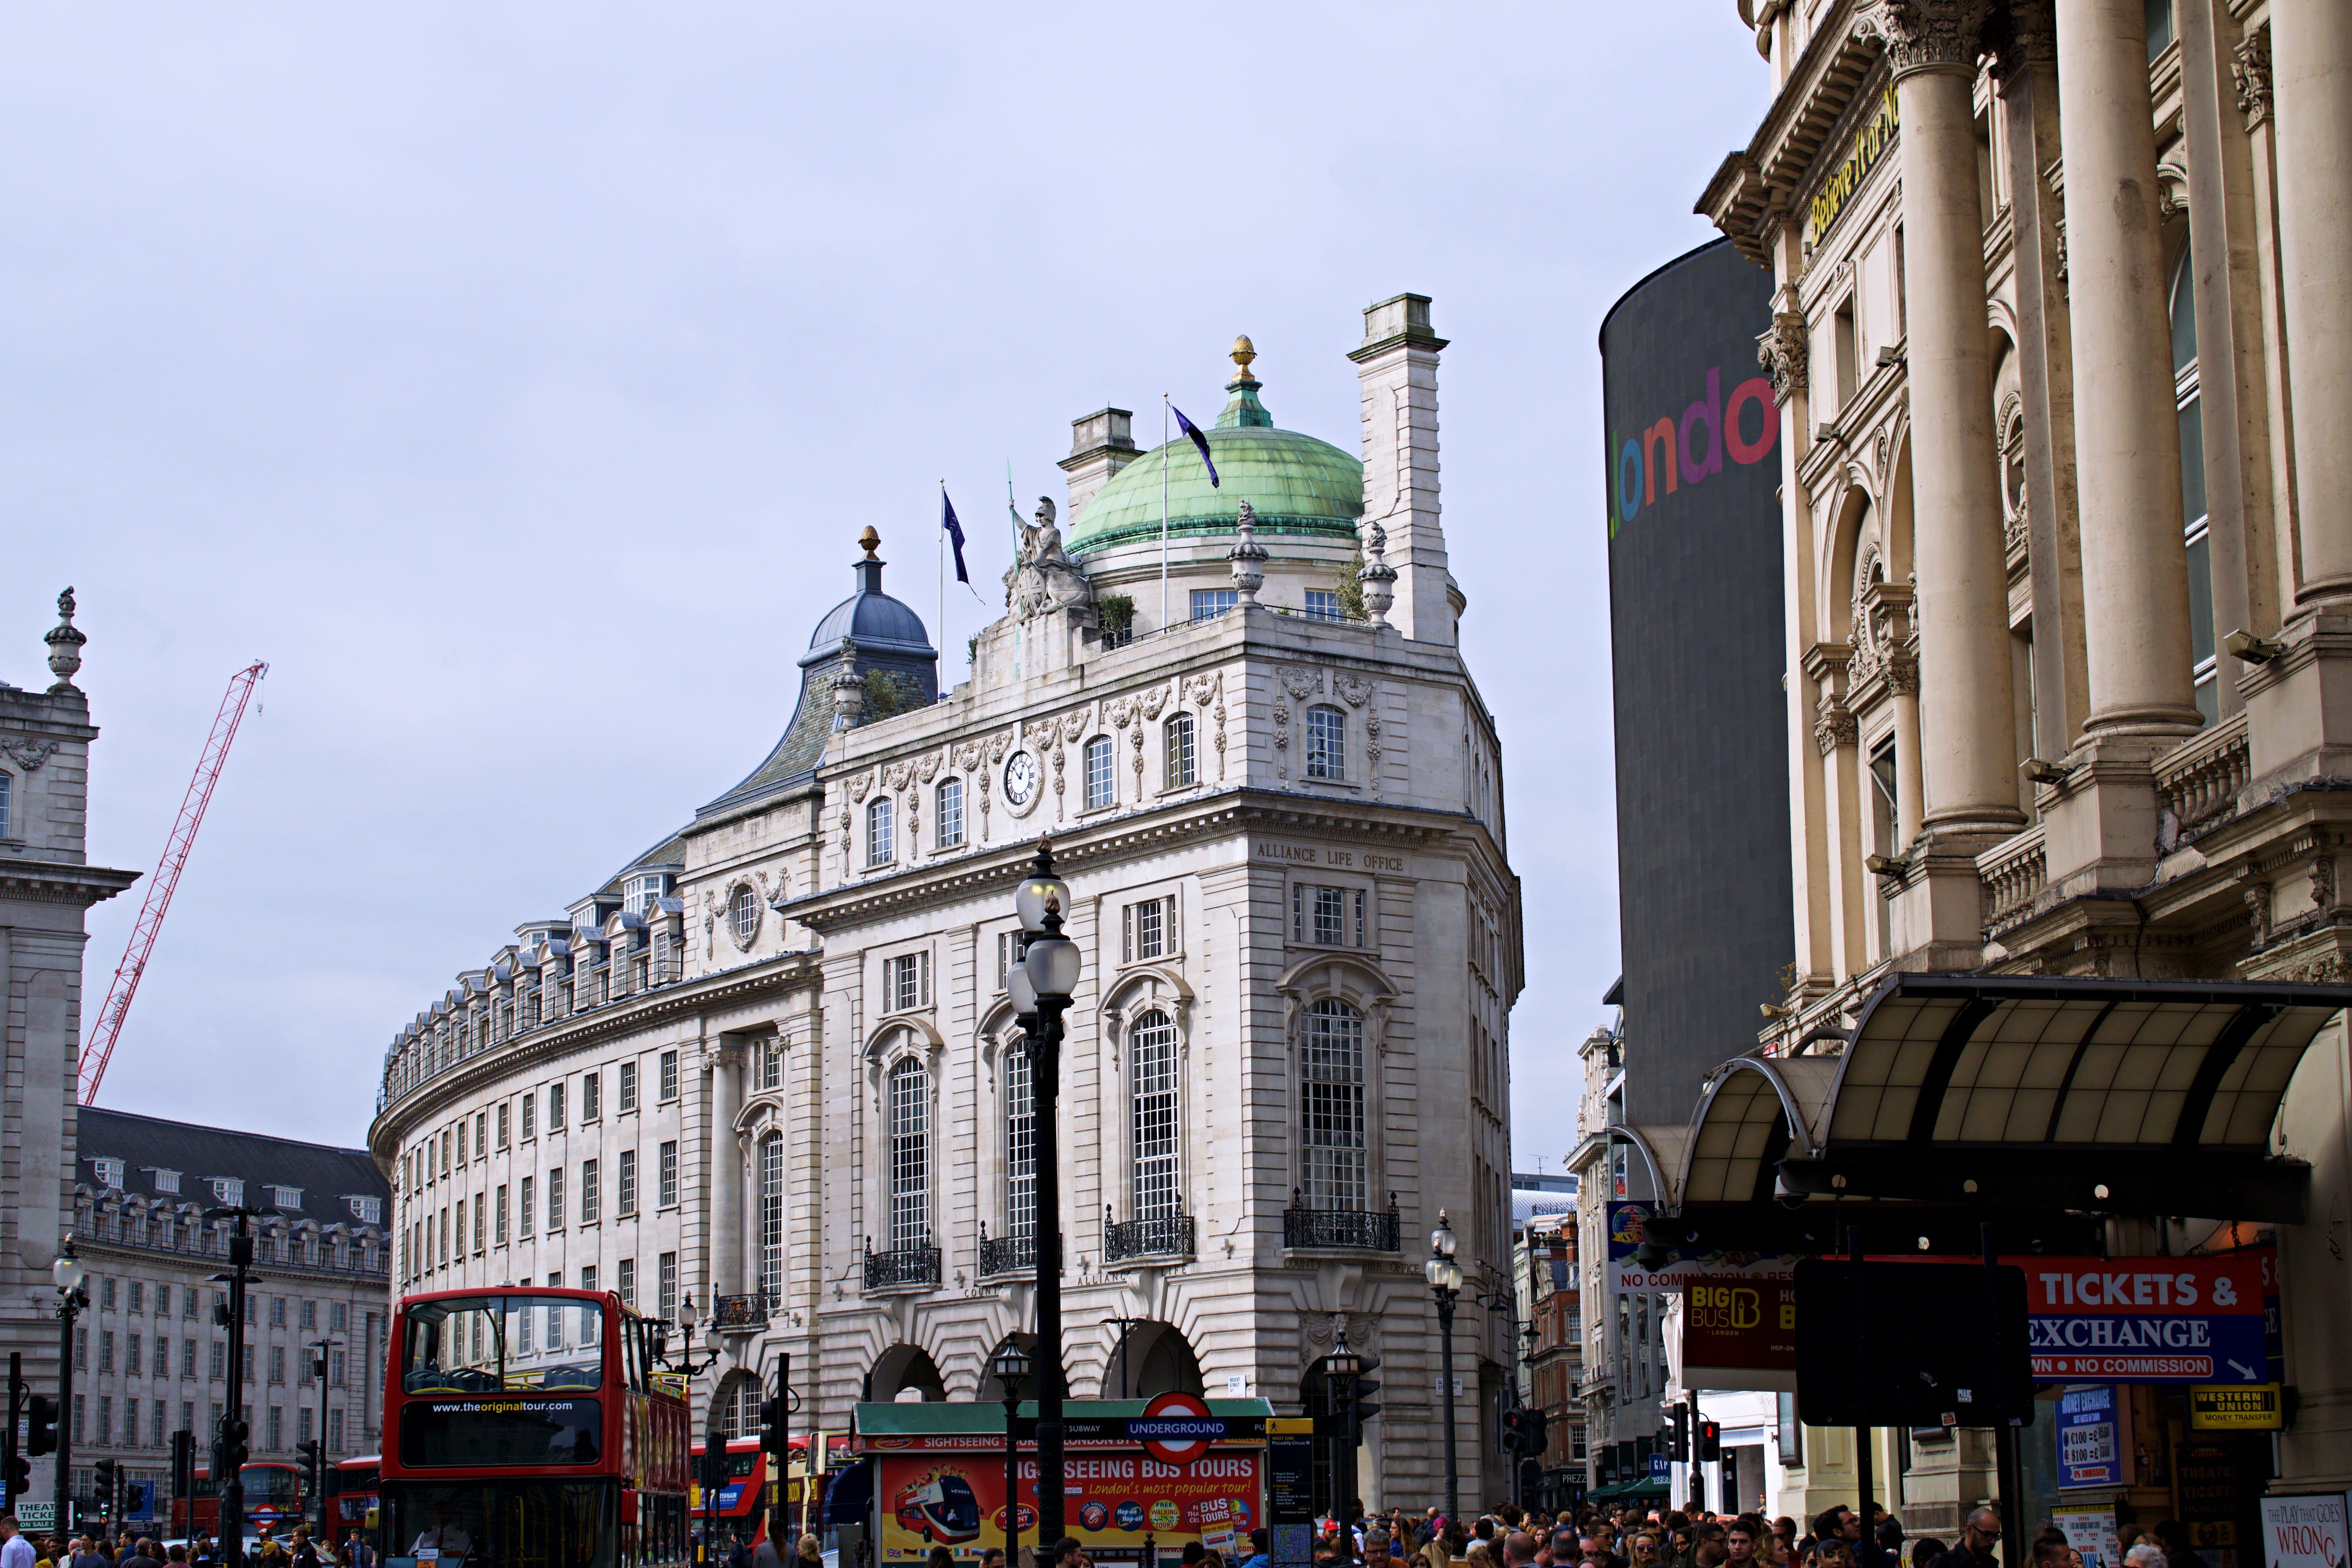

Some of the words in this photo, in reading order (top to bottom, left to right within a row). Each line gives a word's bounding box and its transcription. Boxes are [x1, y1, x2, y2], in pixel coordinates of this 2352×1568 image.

[1811, 160, 1852, 248] Believe
[1855, 127, 1866, 186] It
[1867, 117, 1881, 165] or
[1612, 367, 1780, 533] londo
[1257, 843, 1316, 862] ALLIANCE
[1328, 851, 1352, 866] LIFE
[1364, 855, 1403, 871] OFFICE
[1283, 1259, 1322, 1269] COUNTY
[1363, 1261, 1382, 1271] FIRE
[1389, 1263, 1420, 1273] OFFICE
[1078, 1271, 1126, 1286] ALLIANC
[1161, 1266, 1187, 1277] LIFE
[1621, 1274, 1643, 1287] NO
[964, 1286, 998, 1298] COUNT
[2039, 1273, 2198, 1306] TICKETS
[2212, 1276, 2238, 1306] &
[1691, 1286, 1730, 1308] BIG
[1691, 1308, 1730, 1328] BUS
[2074, 1359, 2098, 1372] NO
[2103, 1358, 2207, 1373] COMMISSION
[2062, 1393, 2081, 1414] MONEY
[2081, 1388, 2110, 1412] EXCHANGE
[2196, 1392, 2261, 1402] WESTERN
[433, 1401, 573, 1414] www.theoriginaltour.com
[2216, 1402, 2261, 1411] UNION
[1130, 1423, 1225, 1434] UNDERGROUND
[924, 1437, 1000, 1447] SIGHTSEEING
[1142, 1460, 1181, 1478] BUS
[1190, 1459, 1252, 1477] TOURS
[1654, 1459, 1668, 1470] GAP
[1562, 1474, 1587, 1484] PREZZ
[2074, 1470, 2080, 1479] 0%
[1089, 1481, 1139, 1494] London's
[1143, 1483, 1172, 1493] most
[1174, 1481, 1221, 1496] popular
[1221, 1479, 1252, 1490] tour!
[278, 1504, 290, 1512] 94
[1081, 1502, 1090, 1512] LIVE
[1091, 1501, 1107, 1512] GUIDES
[1200, 1498, 1228, 1513] BUS
[1122, 1515, 1144, 1523] Hop-off
[1200, 1510, 1230, 1523] TOURS
[2268, 1509, 2280, 1523] THE
[2280, 1505, 2299, 1523] PLAY
[2299, 1508, 2315, 1522] THAT
[2316, 1504, 2340, 1523] GOES
[1217, 1523, 1232, 1531] hop-off
[2276, 1526, 2336, 1568] WRONG
